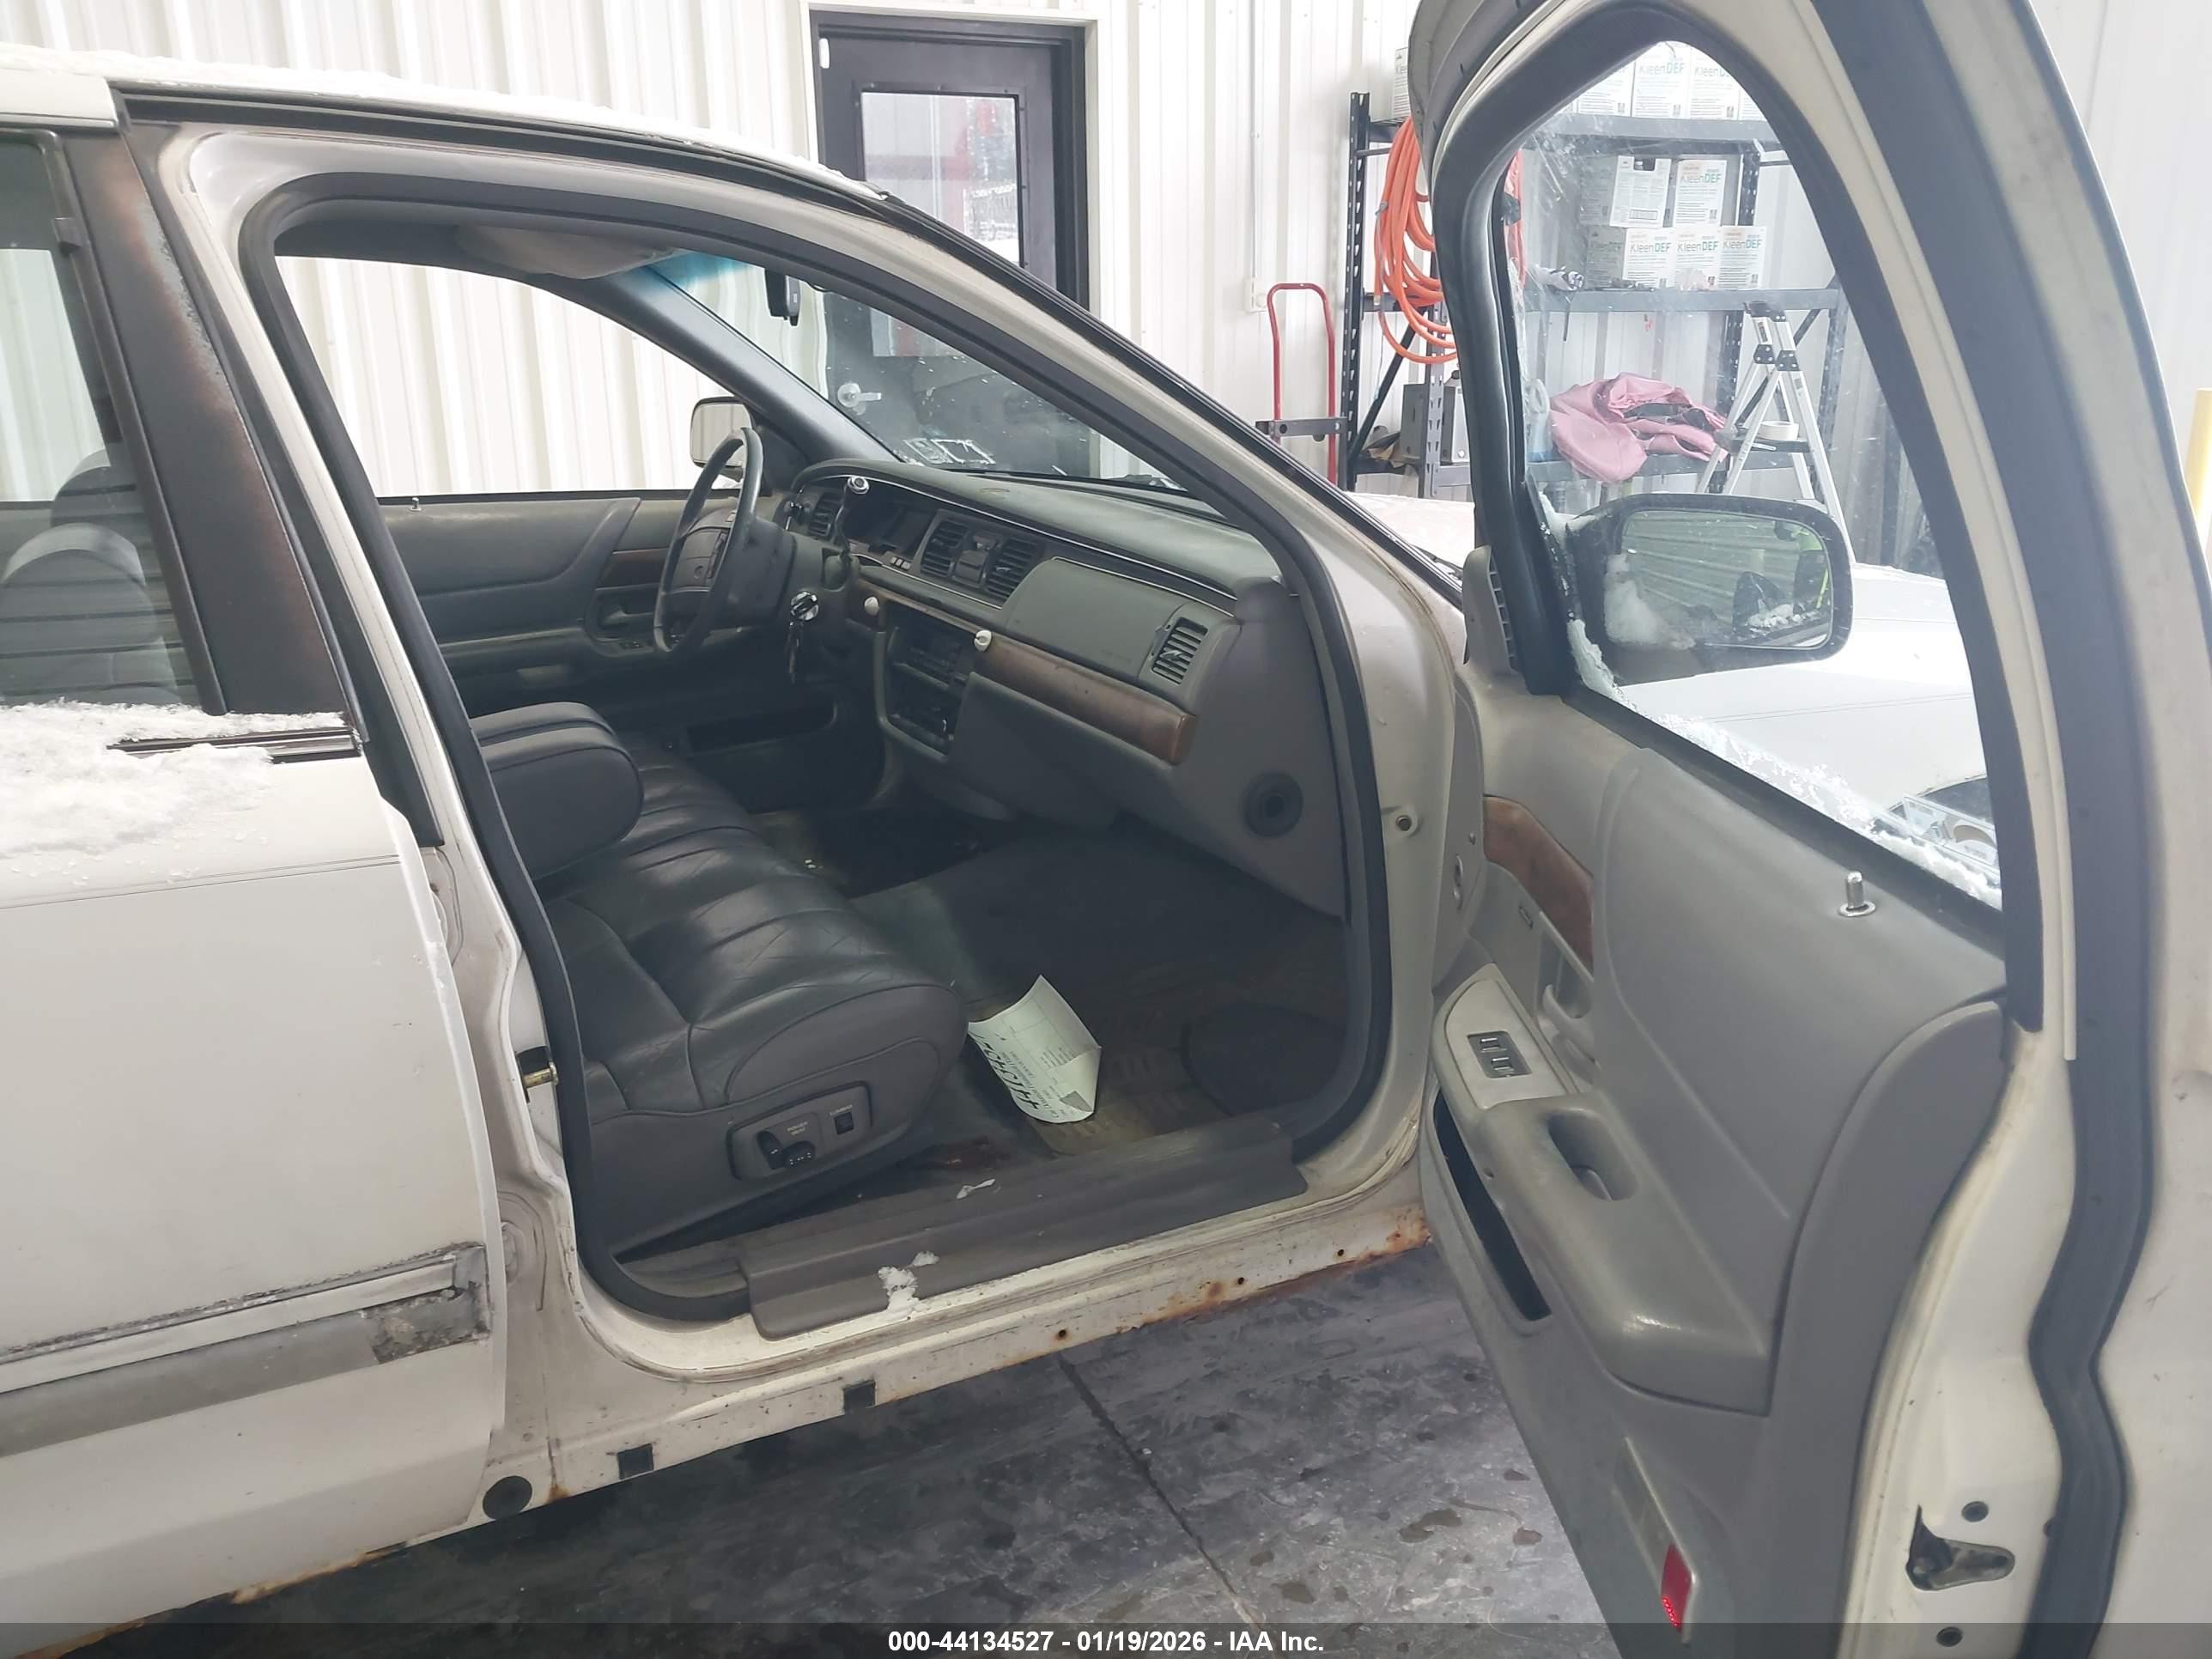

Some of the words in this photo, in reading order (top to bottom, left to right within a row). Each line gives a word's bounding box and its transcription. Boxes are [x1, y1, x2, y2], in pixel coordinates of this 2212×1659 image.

[1638, 62, 1685, 76] KleenDEF
[1680, 173, 1722, 185] KleenDEF
[1630, 242, 1672, 253] KleenDEF
[1676, 241, 1718, 252] KleenDEF
[1723, 239, 1763, 250] KleenDEF
